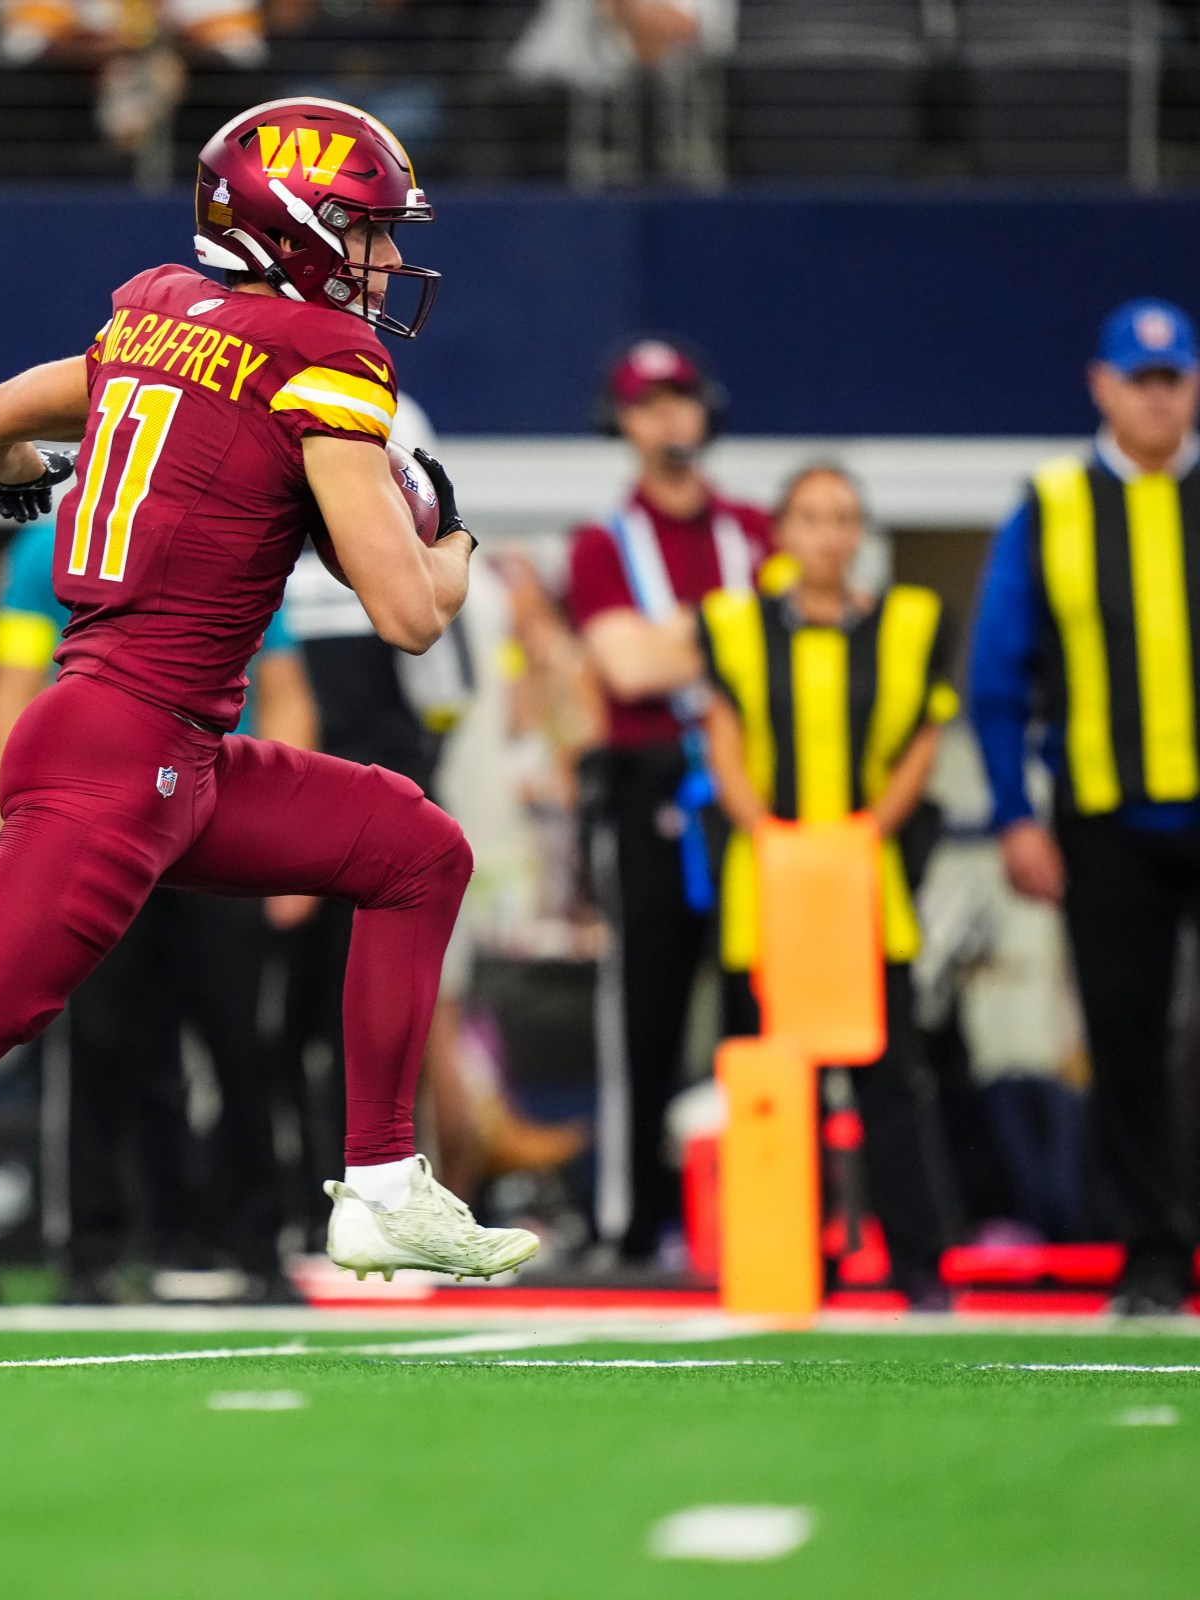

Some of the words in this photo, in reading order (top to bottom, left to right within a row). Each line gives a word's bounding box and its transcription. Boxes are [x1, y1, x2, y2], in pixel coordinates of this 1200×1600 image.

[257, 126, 357, 186] W
[101, 309, 270, 401] McCAFFREY
[67, 376, 184, 582] 11
